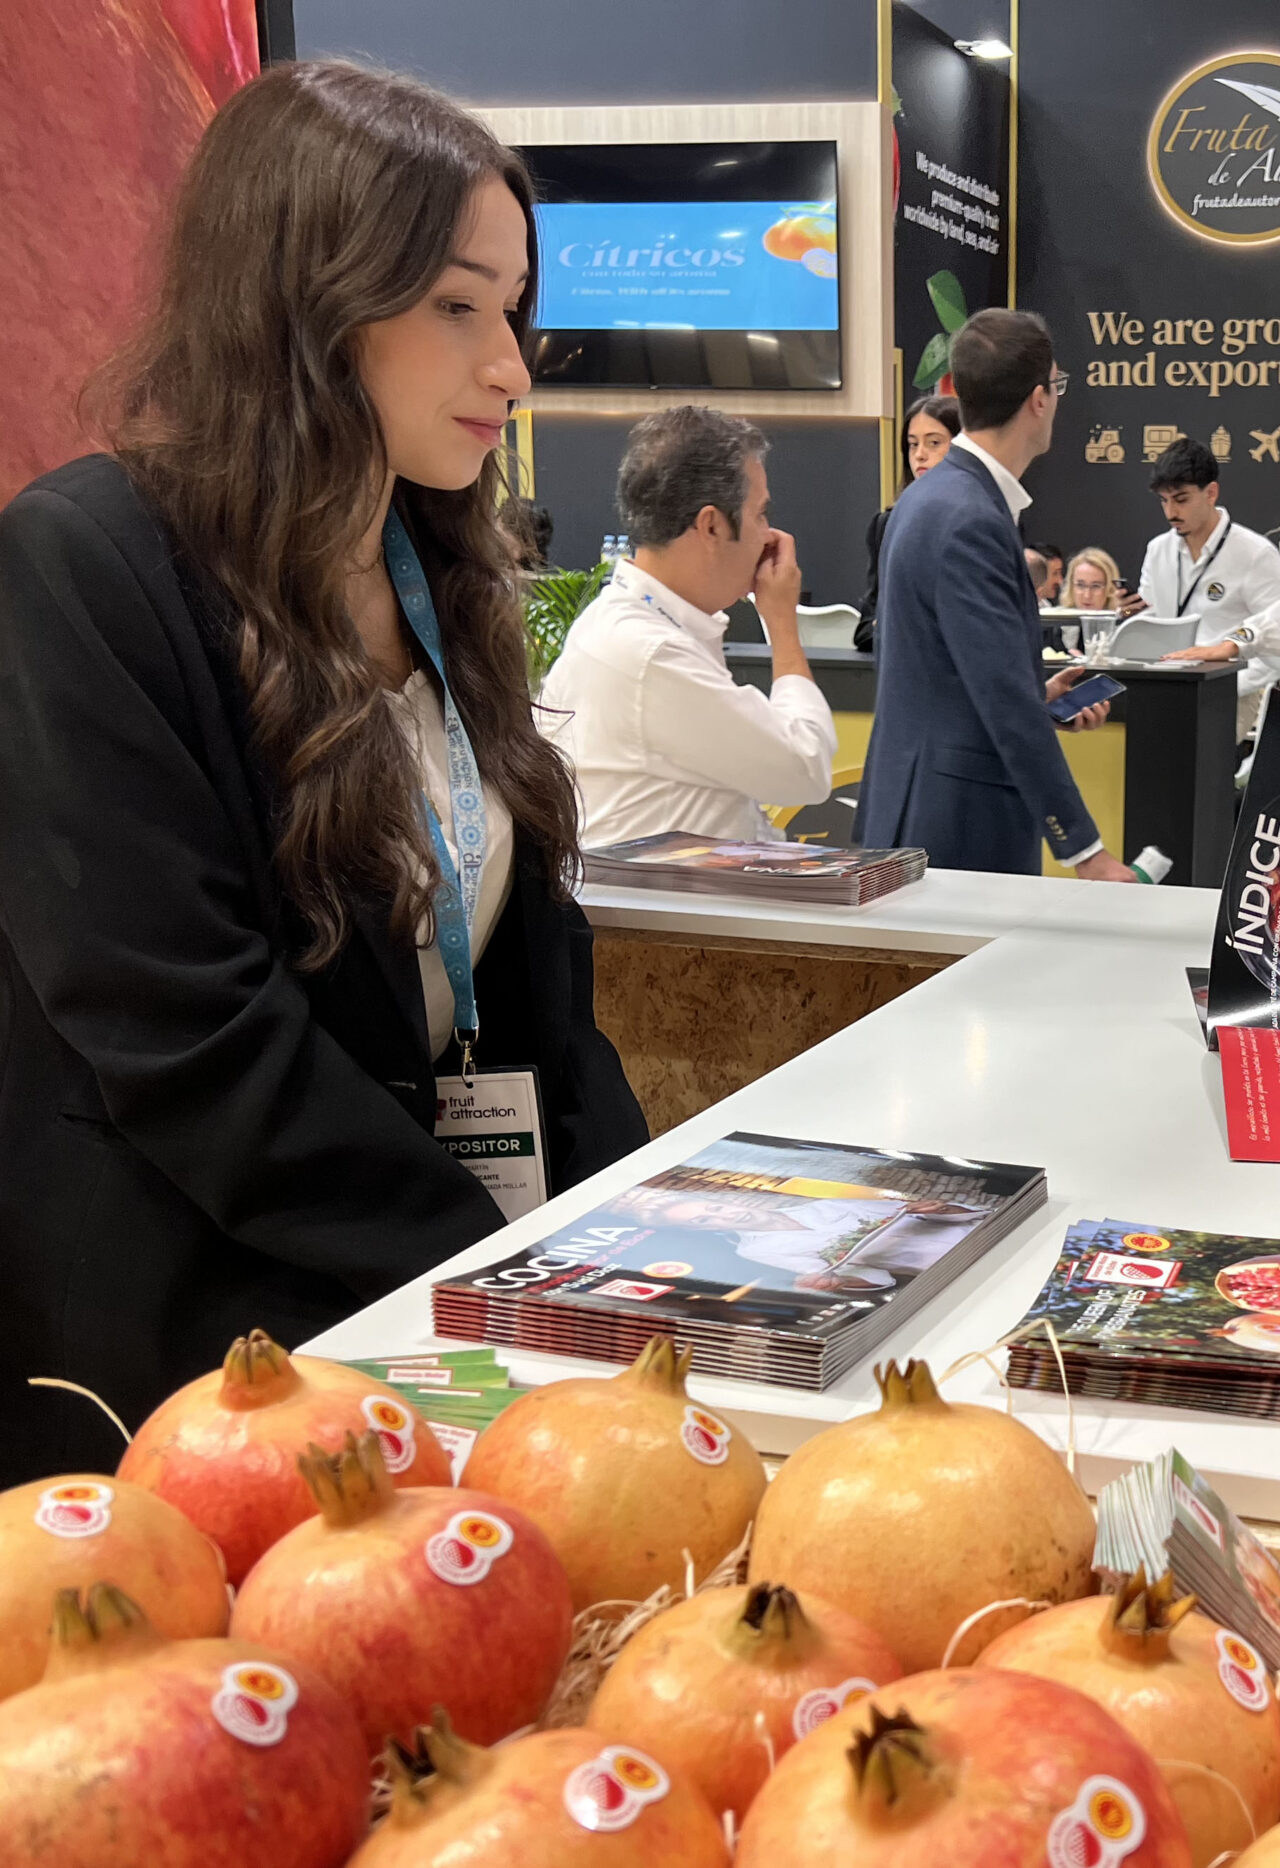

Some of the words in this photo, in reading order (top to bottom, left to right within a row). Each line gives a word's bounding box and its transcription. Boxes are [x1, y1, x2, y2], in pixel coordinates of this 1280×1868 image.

[1164, 105, 1278, 152] Fruta
[1208, 152, 1236, 186] de
[558, 240, 745, 268] Cítricos
[1086, 312, 1145, 346] We
[1152, 318, 1214, 346] are
[1086, 351, 1157, 388] and
[449, 1095, 475, 1108] fruit
[450, 1106, 516, 1120] attraction
[442, 1138, 521, 1154] POSITOR
[471, 1226, 639, 1290] COCINA
[1095, 1288, 1116, 1304] OF
